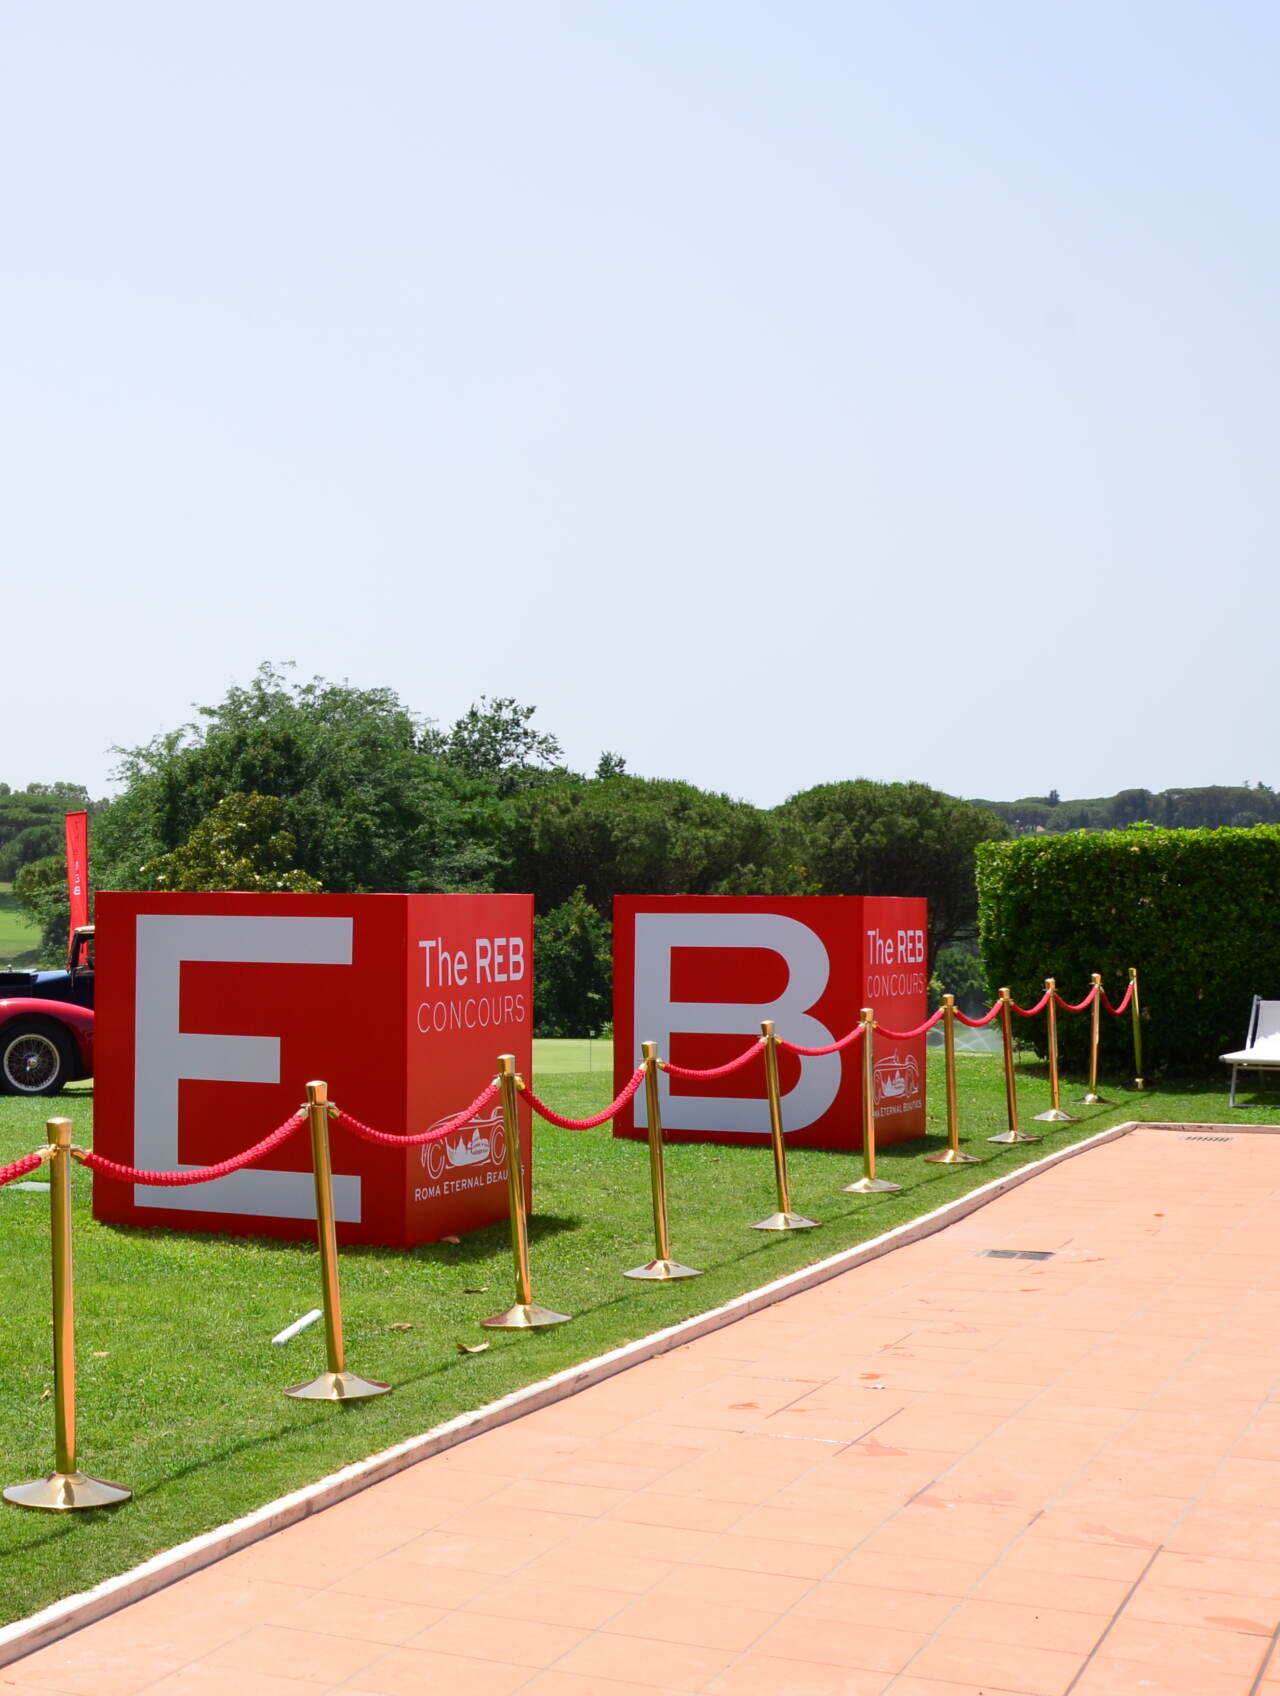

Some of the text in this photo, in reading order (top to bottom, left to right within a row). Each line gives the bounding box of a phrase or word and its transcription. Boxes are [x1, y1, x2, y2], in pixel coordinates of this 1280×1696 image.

[418, 936, 525, 988] The REB
[867, 927, 924, 965] The REB
[866, 972, 924, 998] CONCOURS
[417, 994, 525, 1033] CONCOURS
[633, 912, 842, 1134] B
[134, 914, 362, 1223] E
[414, 1164, 525, 1201] ROMA ETERNAL BEAUS
